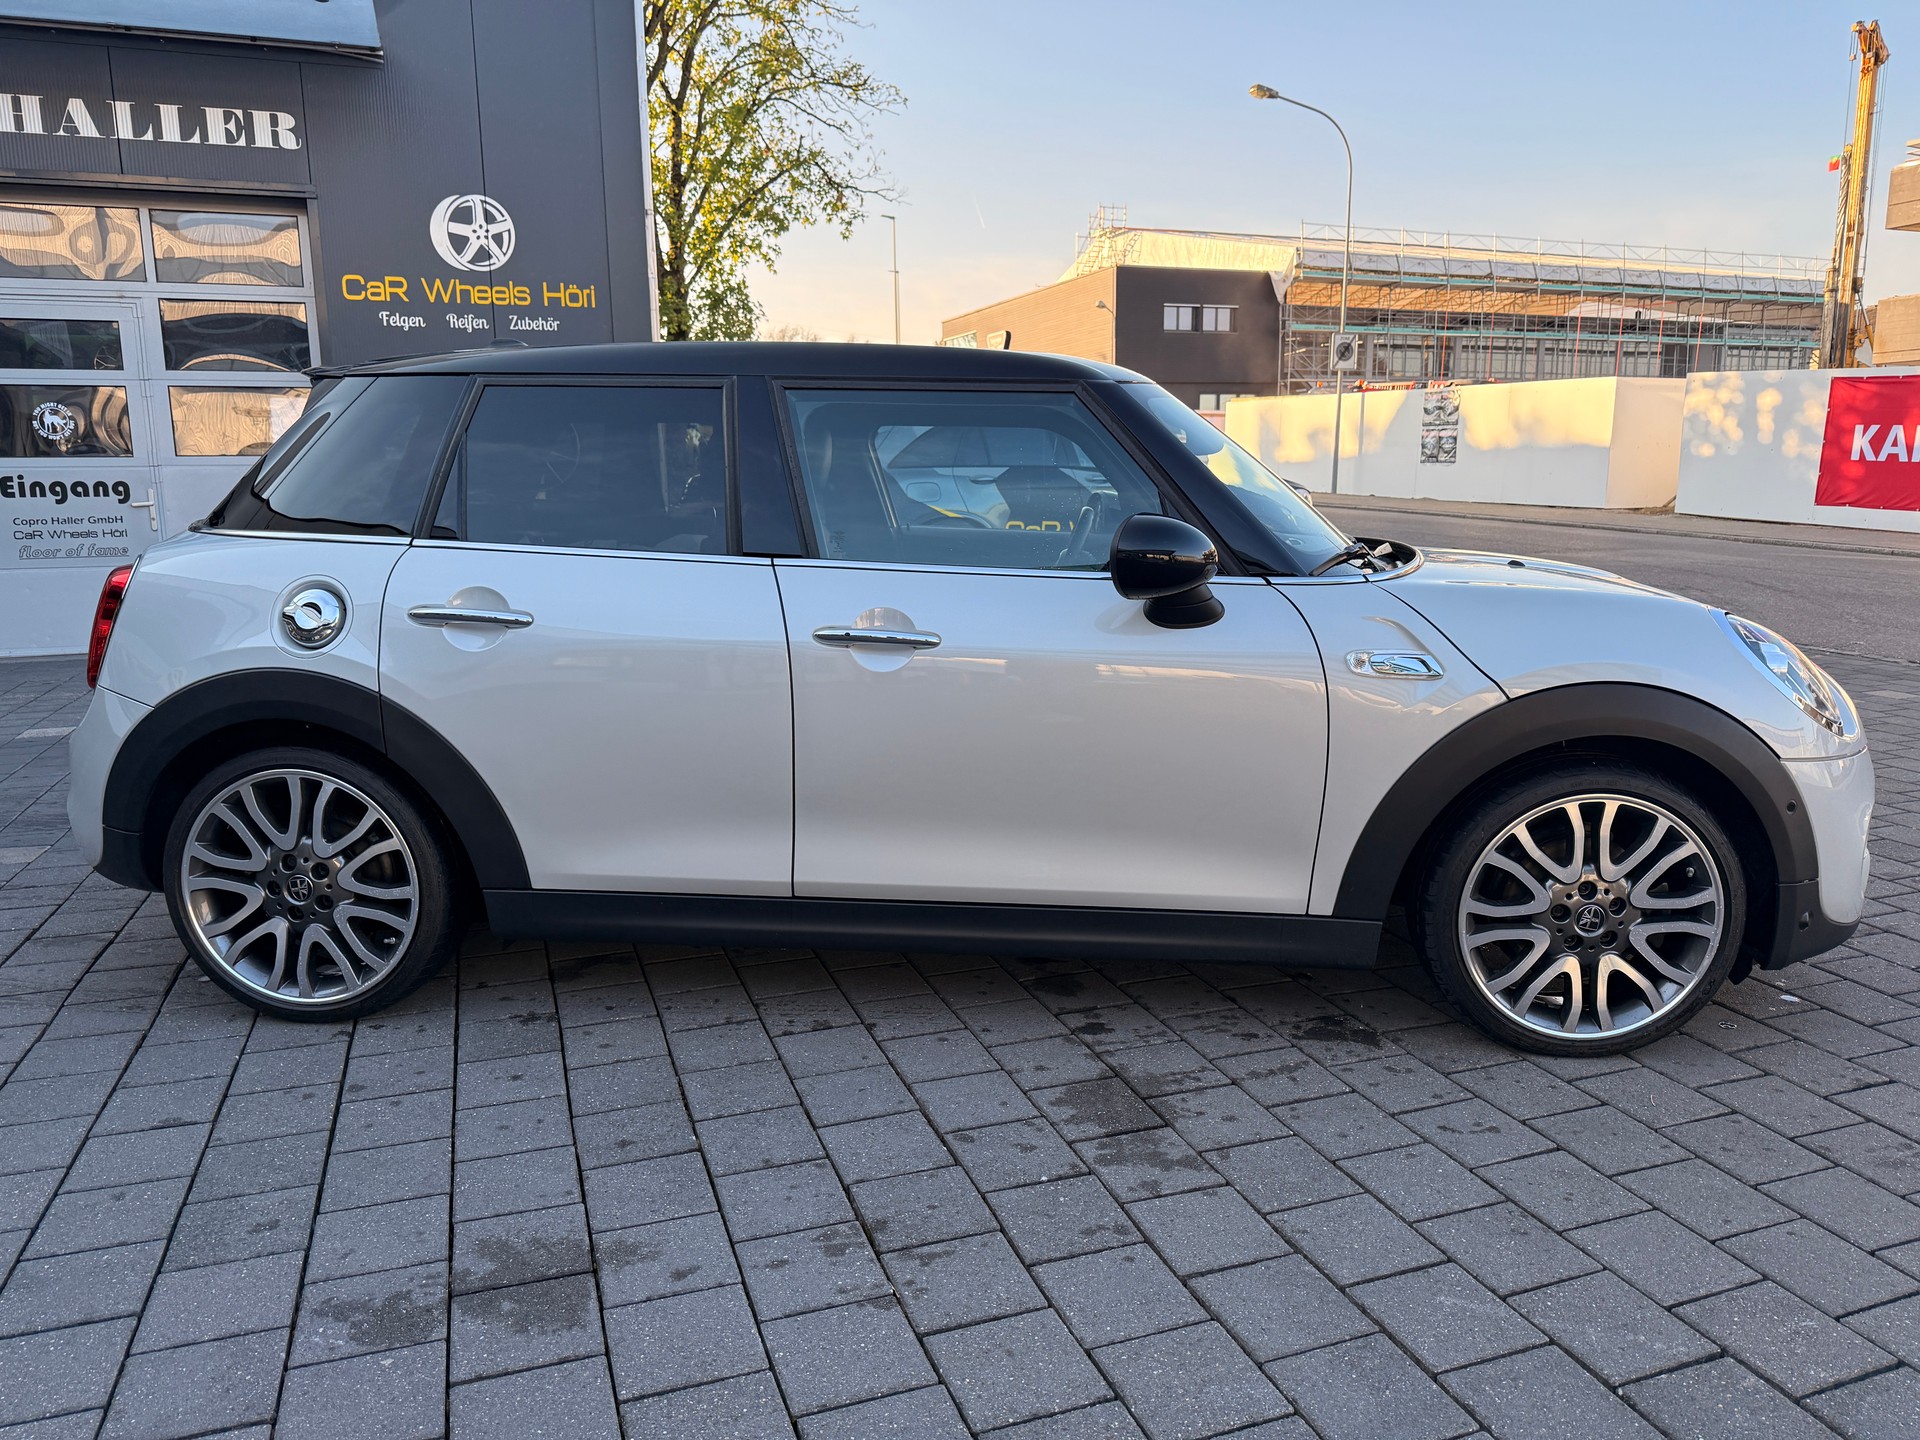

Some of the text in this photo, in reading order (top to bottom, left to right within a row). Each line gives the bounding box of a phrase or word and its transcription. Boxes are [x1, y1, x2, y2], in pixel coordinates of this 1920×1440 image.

[0, 93, 302, 150] HALLER
[341, 274, 596, 308] CaR Wheels Höri
[378, 311, 560, 333] Felgen Reifen Zubehör
[0, 474, 131, 505] Eingang
[13, 515, 124, 527] Copro Haller GmbH
[13, 528, 128, 540] CaR Wheels Höri
[19, 543, 129, 558] floor of fame
